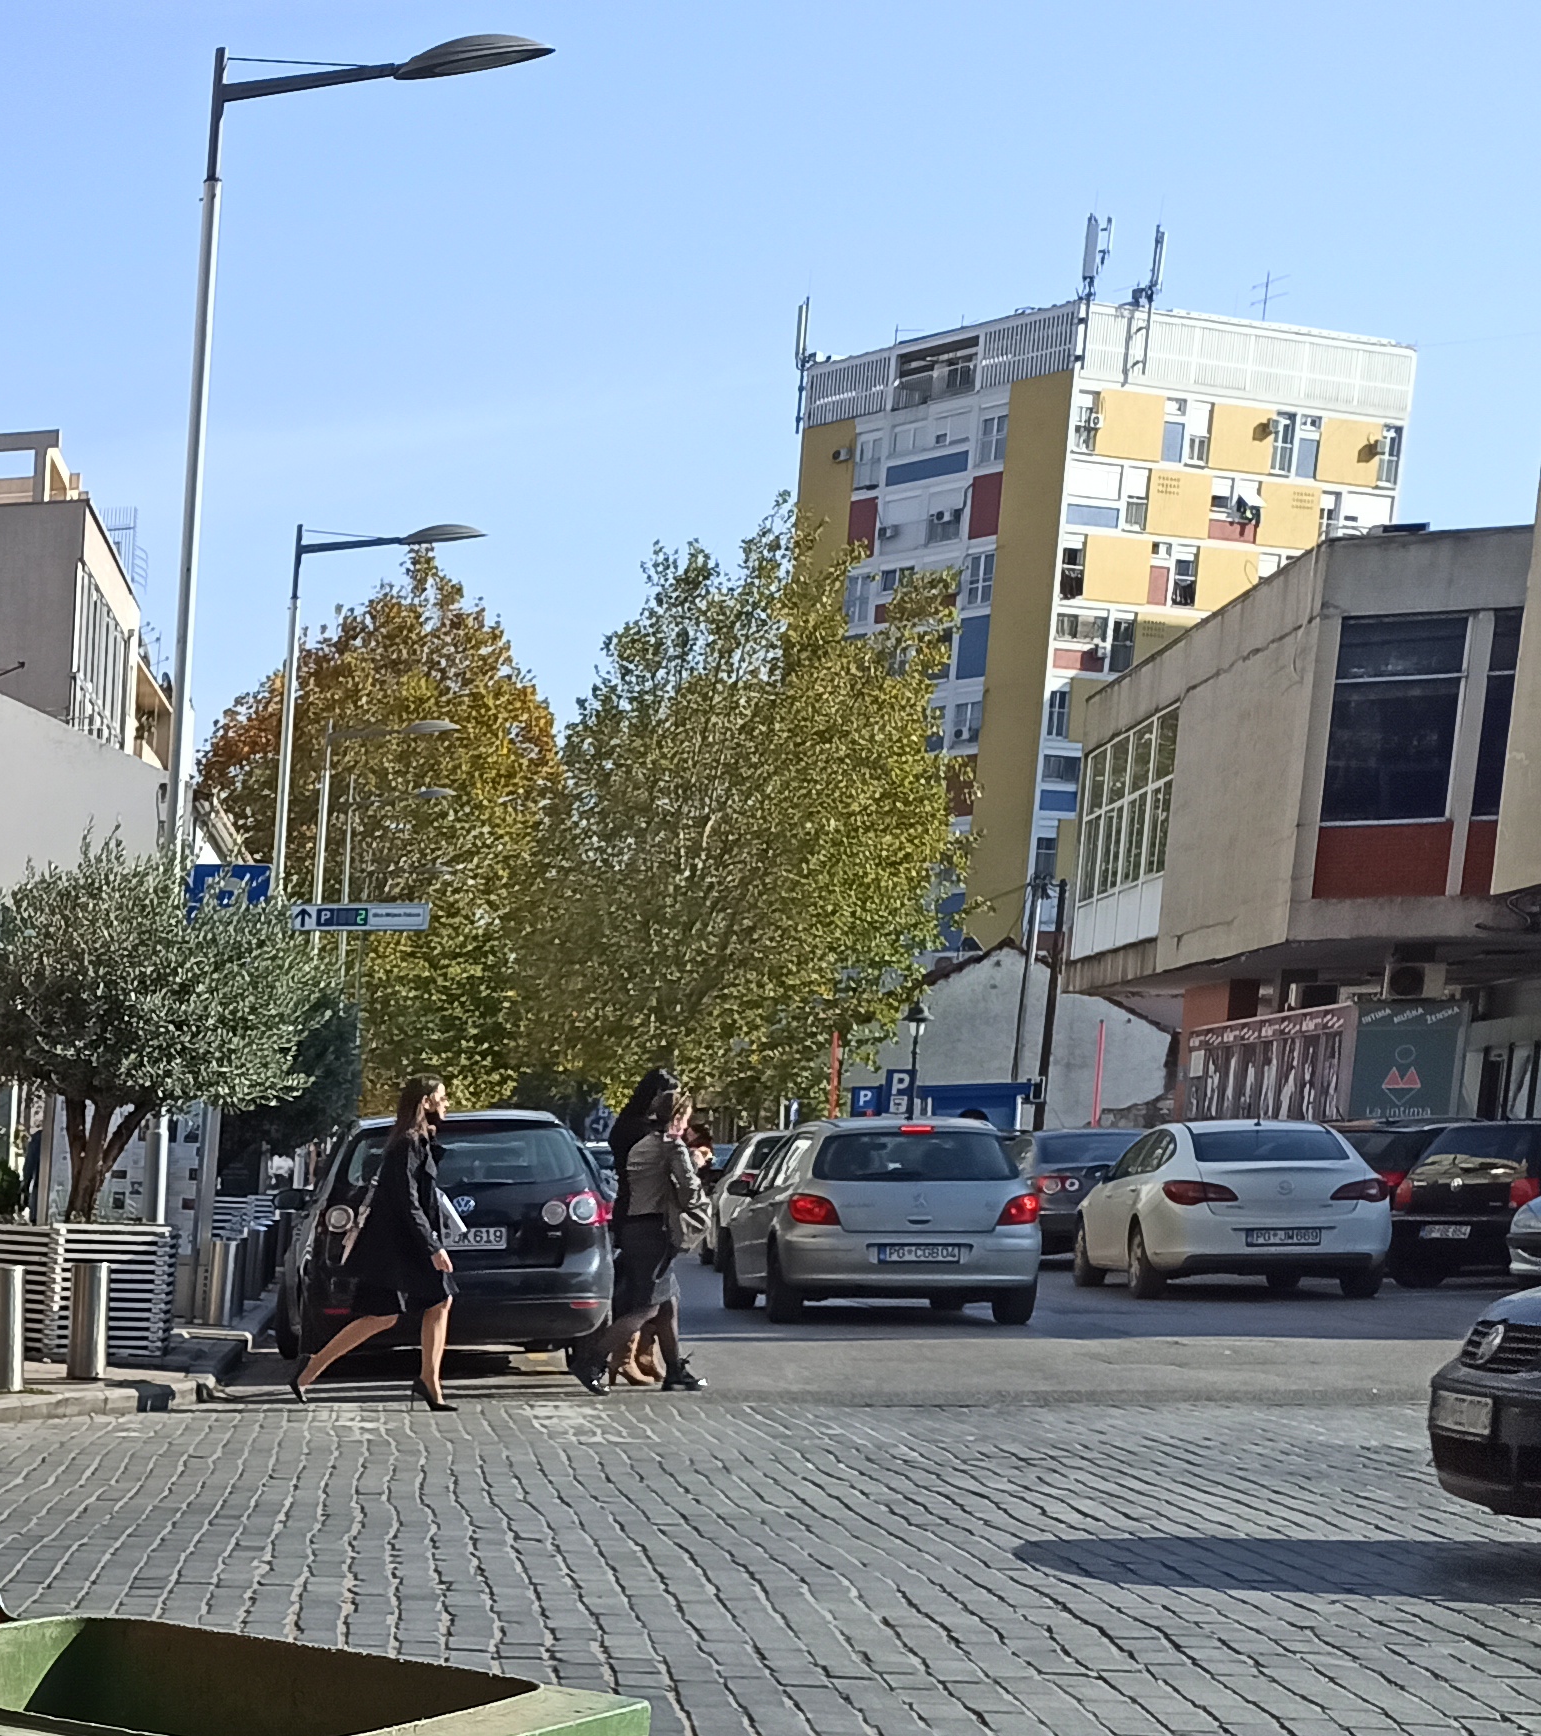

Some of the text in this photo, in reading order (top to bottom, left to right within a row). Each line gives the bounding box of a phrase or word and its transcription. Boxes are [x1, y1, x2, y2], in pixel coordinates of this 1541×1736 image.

[320, 911, 331, 923] P
[892, 1072, 910, 1095] P
[859, 1090, 872, 1106] P
[1366, 1105, 1431, 1117] La intima
[1255, 1231, 1271, 1241] PG
[888, 1247, 906, 1259] PG
